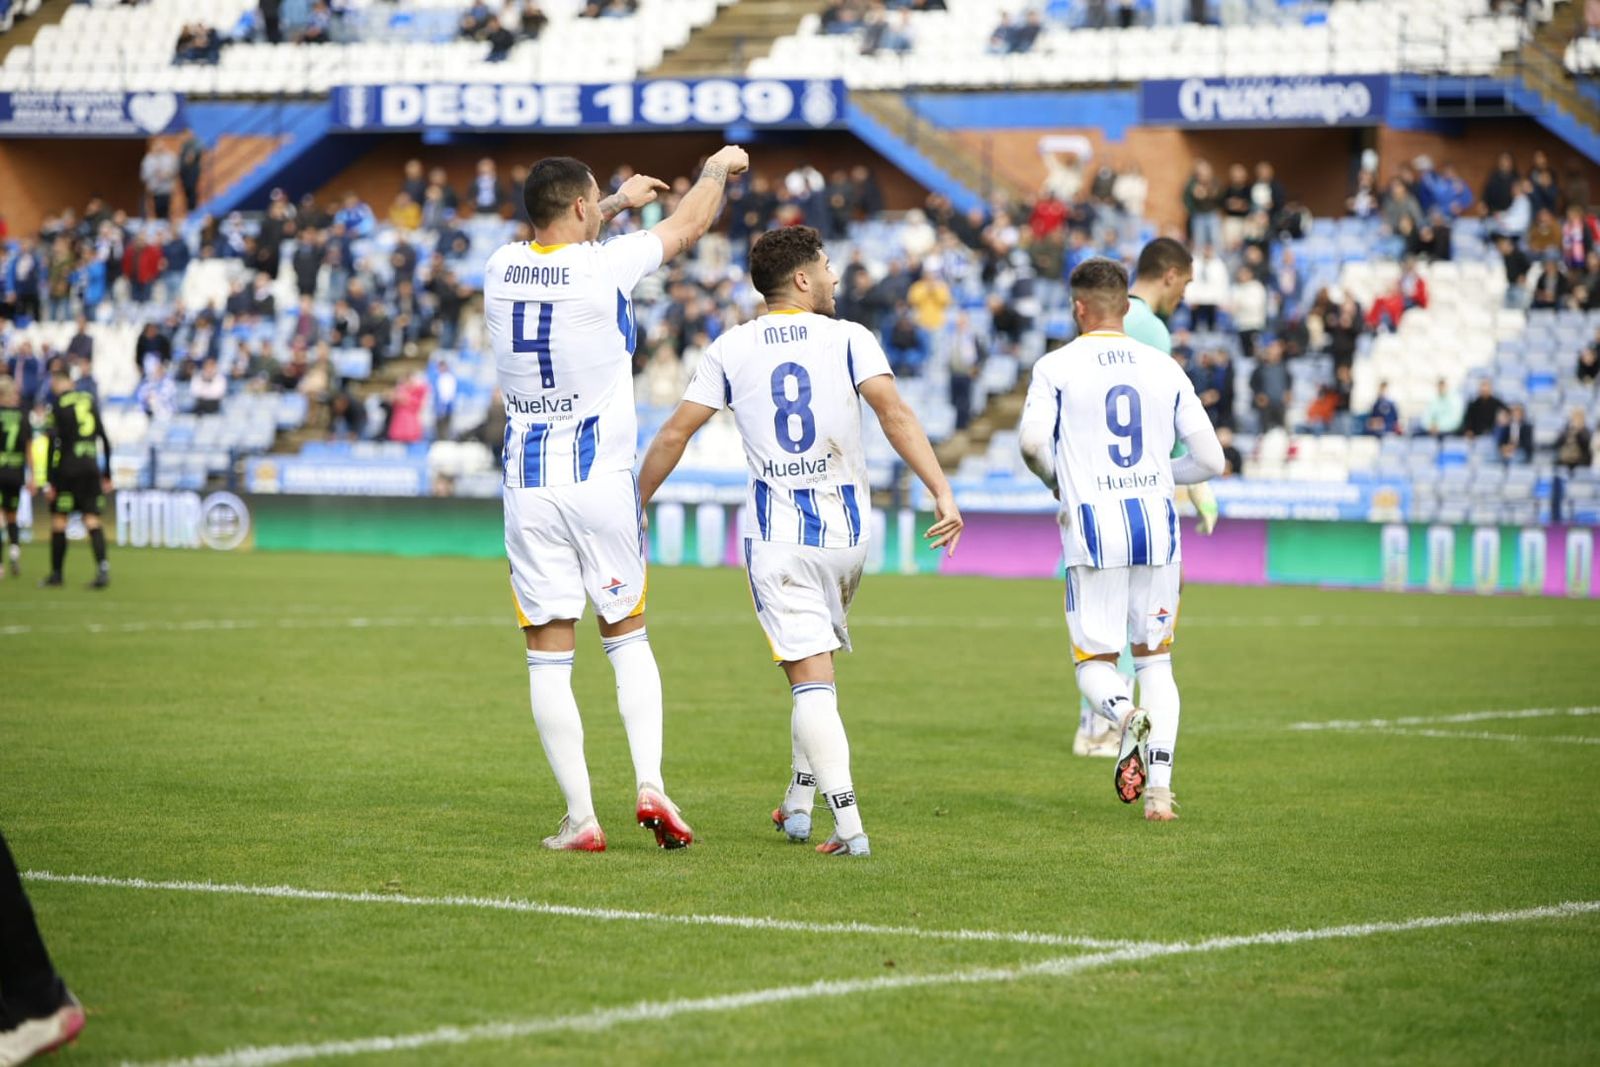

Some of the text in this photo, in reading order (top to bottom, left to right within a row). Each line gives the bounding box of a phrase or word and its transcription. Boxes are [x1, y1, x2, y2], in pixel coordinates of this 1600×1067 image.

[381, 80, 794, 127] DESDE 1889
[504, 265, 570, 288] BONAQUE
[512, 301, 555, 389] 4
[764, 325, 808, 345] MENA
[1097, 350, 1136, 366] CAYE
[60, 391, 96, 437] 3
[506, 393, 573, 414] Huelva
[771, 361, 816, 454] 8
[0, 410, 22, 451] 7
[1105, 384, 1143, 468] 9
[763, 457, 827, 478] Huelva
[1097, 472, 1158, 491] Huelva
[835, 791, 856, 808] FS
